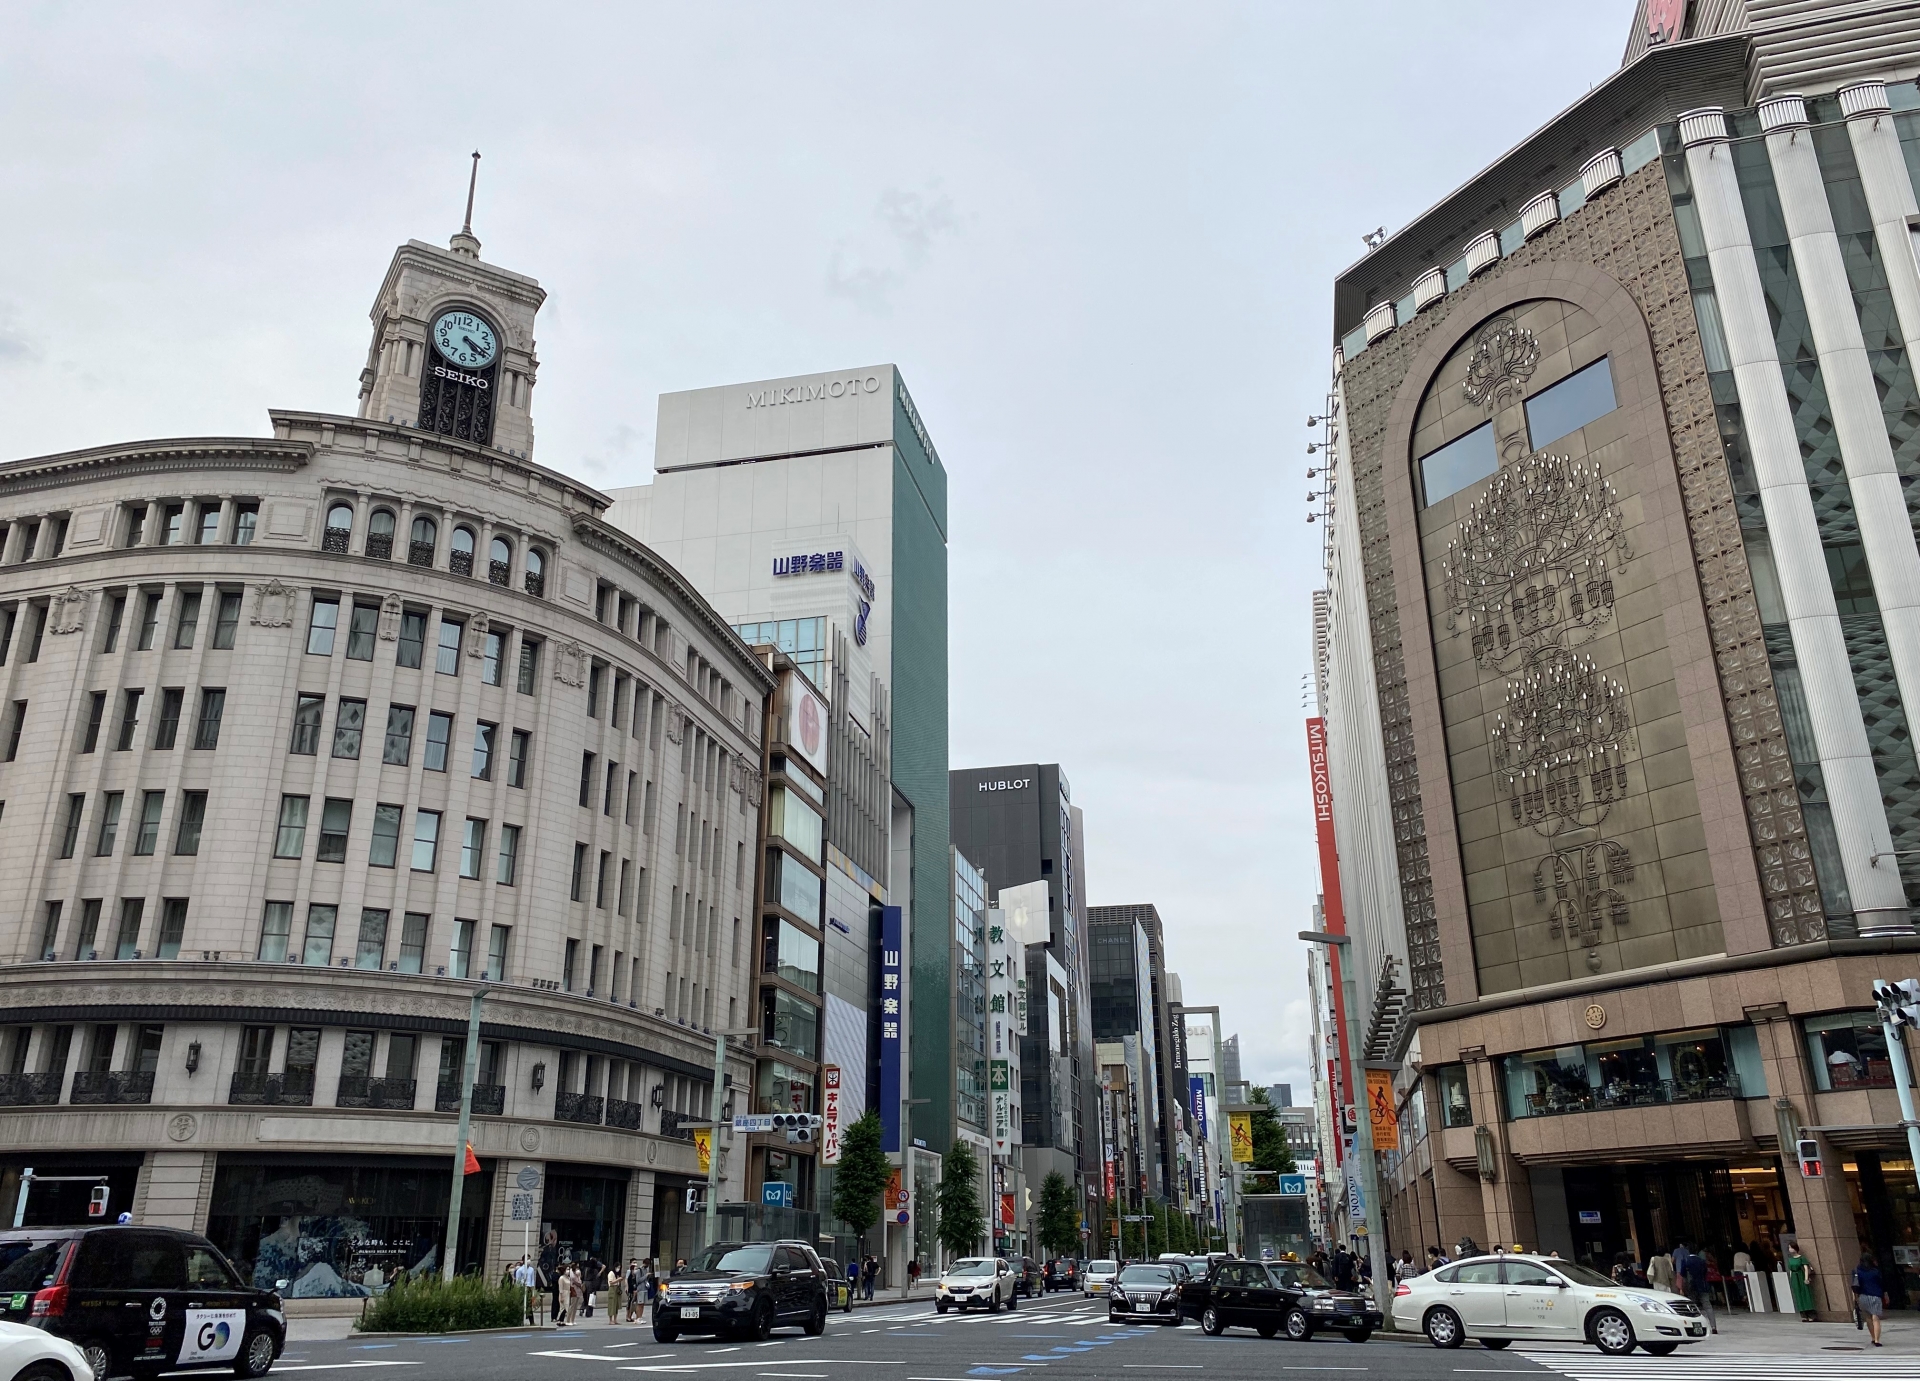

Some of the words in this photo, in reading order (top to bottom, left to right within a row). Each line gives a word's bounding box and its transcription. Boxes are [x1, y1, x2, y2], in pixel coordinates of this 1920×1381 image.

[434, 366, 488, 389] SEIKO
[746, 376, 880, 409] MIKIMOTO
[772, 550, 844, 577] 山野楽器
[852, 555, 876, 601] 山野楽器
[978, 779, 1031, 792] HUBLOT
[1309, 724, 1331, 821] MITSUKOSHI
[989, 925, 1005, 1013] 教文館
[883, 950, 899, 1039] 山野楽器
[1017, 978, 1027, 1031] 教文館ビル
[1172, 1027, 1182, 1069] Ermenegildo
[1186, 1027, 1208, 1036] OLA
[991, 1064, 1007, 1086] 本
[1195, 1089, 1204, 1121] MIZUHO
[735, 1118, 771, 1127] 銀座四丁目
[825, 1092, 839, 1159] キムラヤのパン
